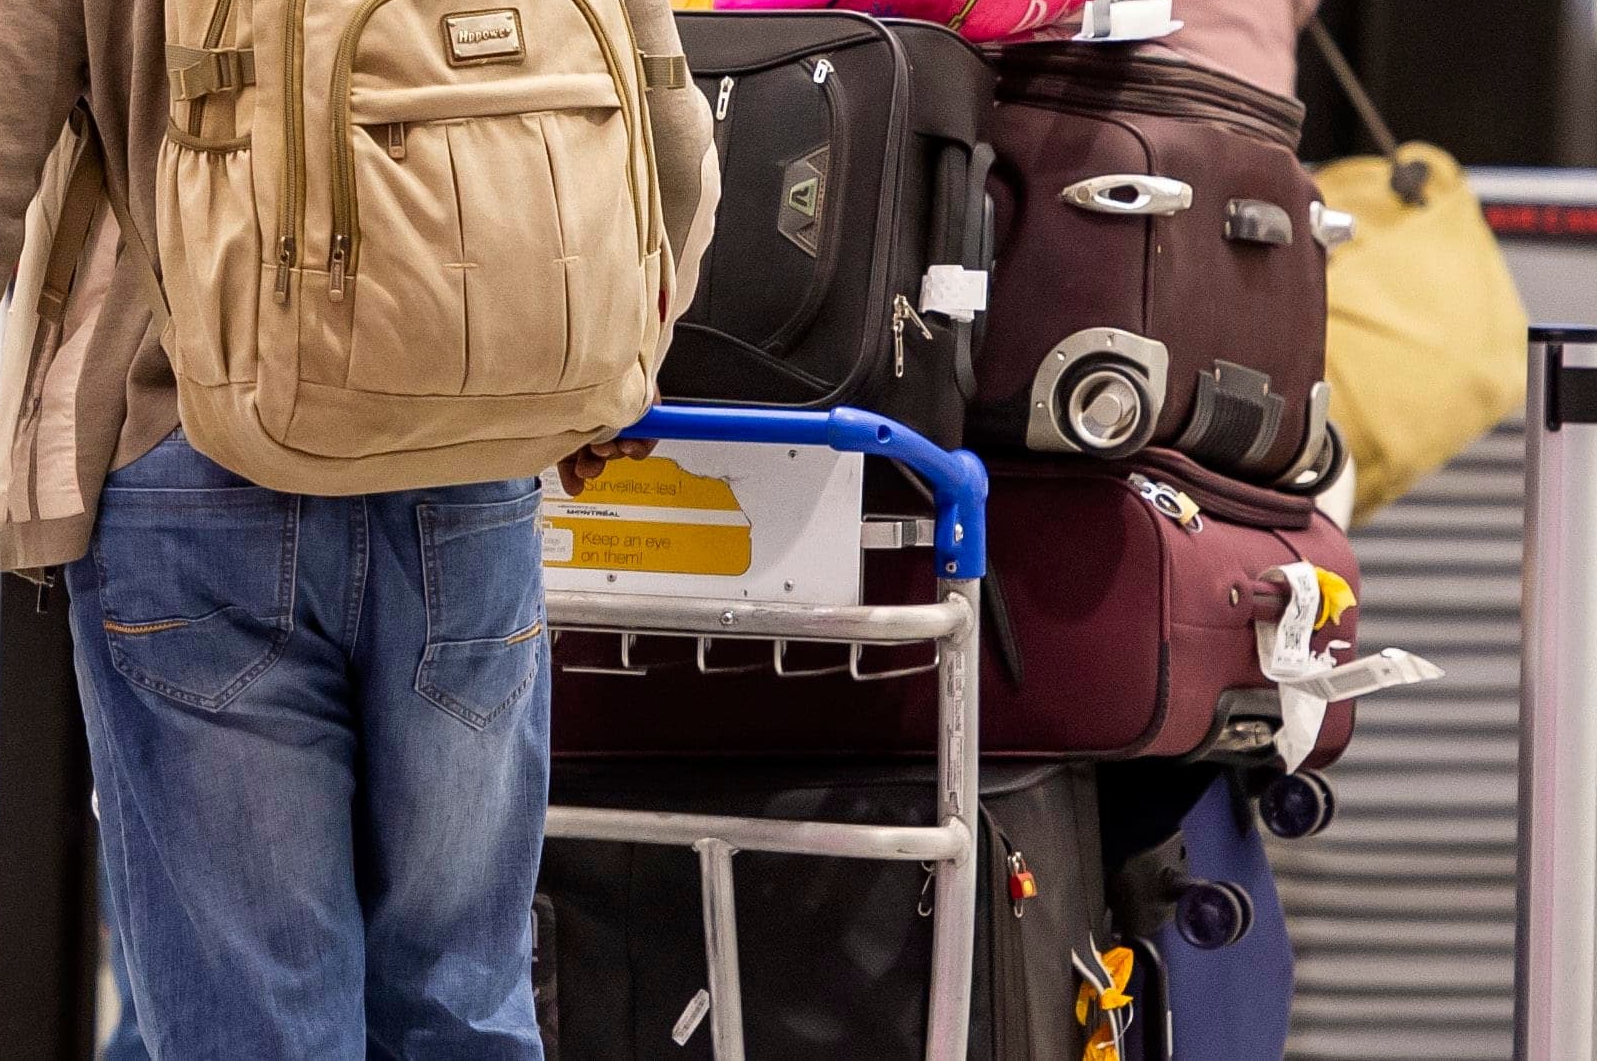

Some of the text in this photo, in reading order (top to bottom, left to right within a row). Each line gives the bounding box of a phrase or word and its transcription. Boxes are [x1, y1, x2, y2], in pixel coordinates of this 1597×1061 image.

[582, 531, 671, 550] Keep an eye
[580, 549, 643, 565] on them!
